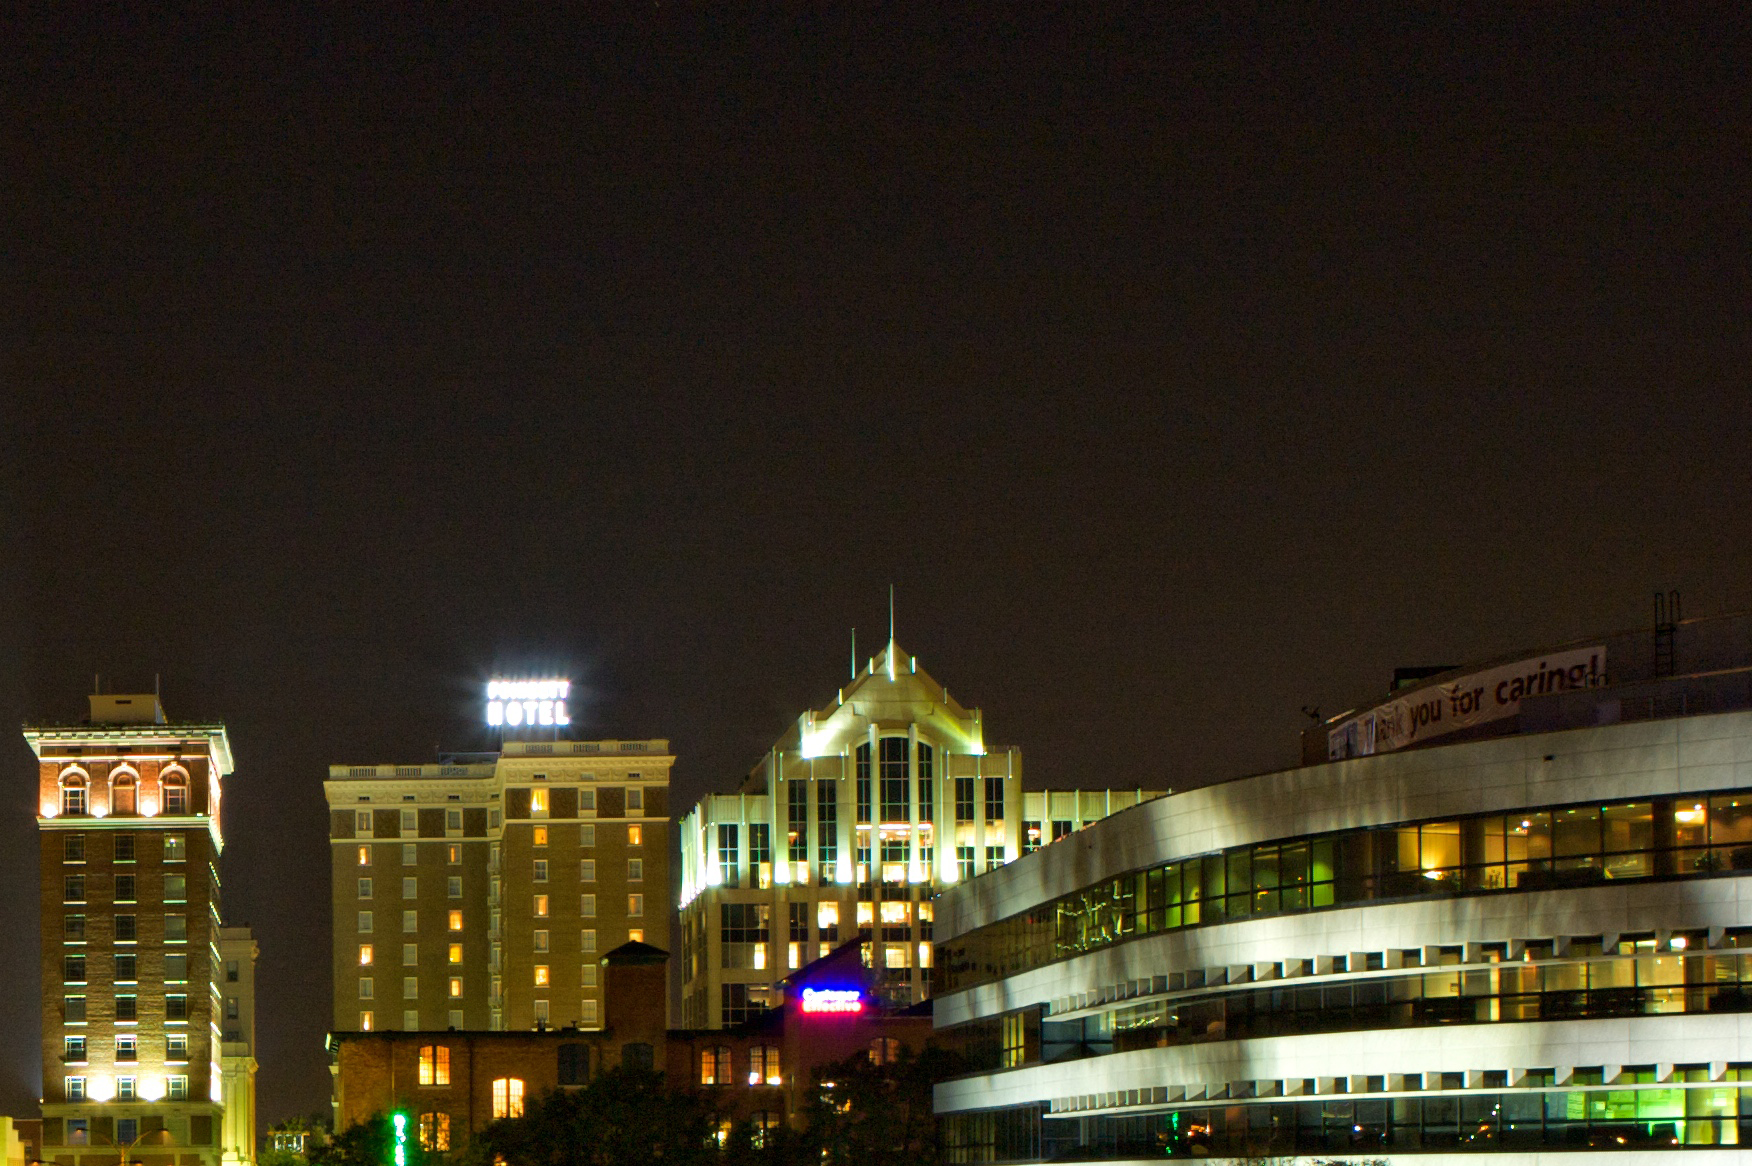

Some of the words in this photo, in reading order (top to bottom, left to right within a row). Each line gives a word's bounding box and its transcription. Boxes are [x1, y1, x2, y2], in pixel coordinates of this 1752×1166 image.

[487, 701, 570, 726] HOTEL
[1410, 698, 1442, 738] you
[1449, 684, 1485, 717] for
[1494, 654, 1599, 706] caring!
